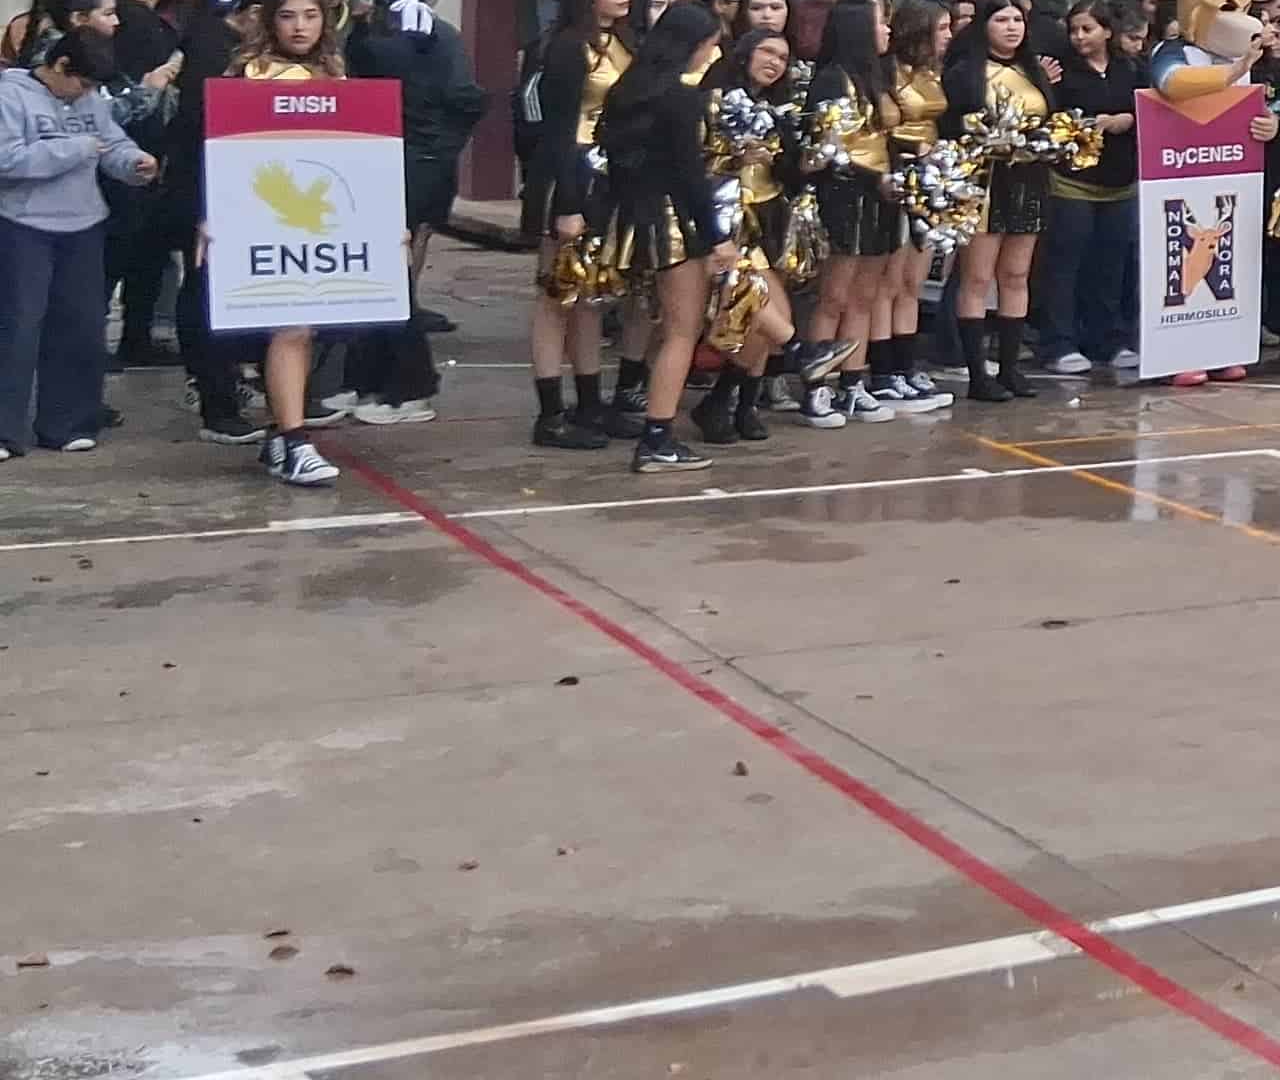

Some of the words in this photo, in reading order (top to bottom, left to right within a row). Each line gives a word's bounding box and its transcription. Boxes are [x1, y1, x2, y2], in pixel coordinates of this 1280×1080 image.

[273, 95, 337, 114] ENSH
[36, 112, 98, 134] ENSH
[1162, 144, 1244, 169] ByCENES
[249, 242, 370, 276] ENSH
[1167, 211, 1182, 296] NORMAL
[1218, 208, 1233, 289] ONORA
[1160, 306, 1239, 325] HERMOSILLO
